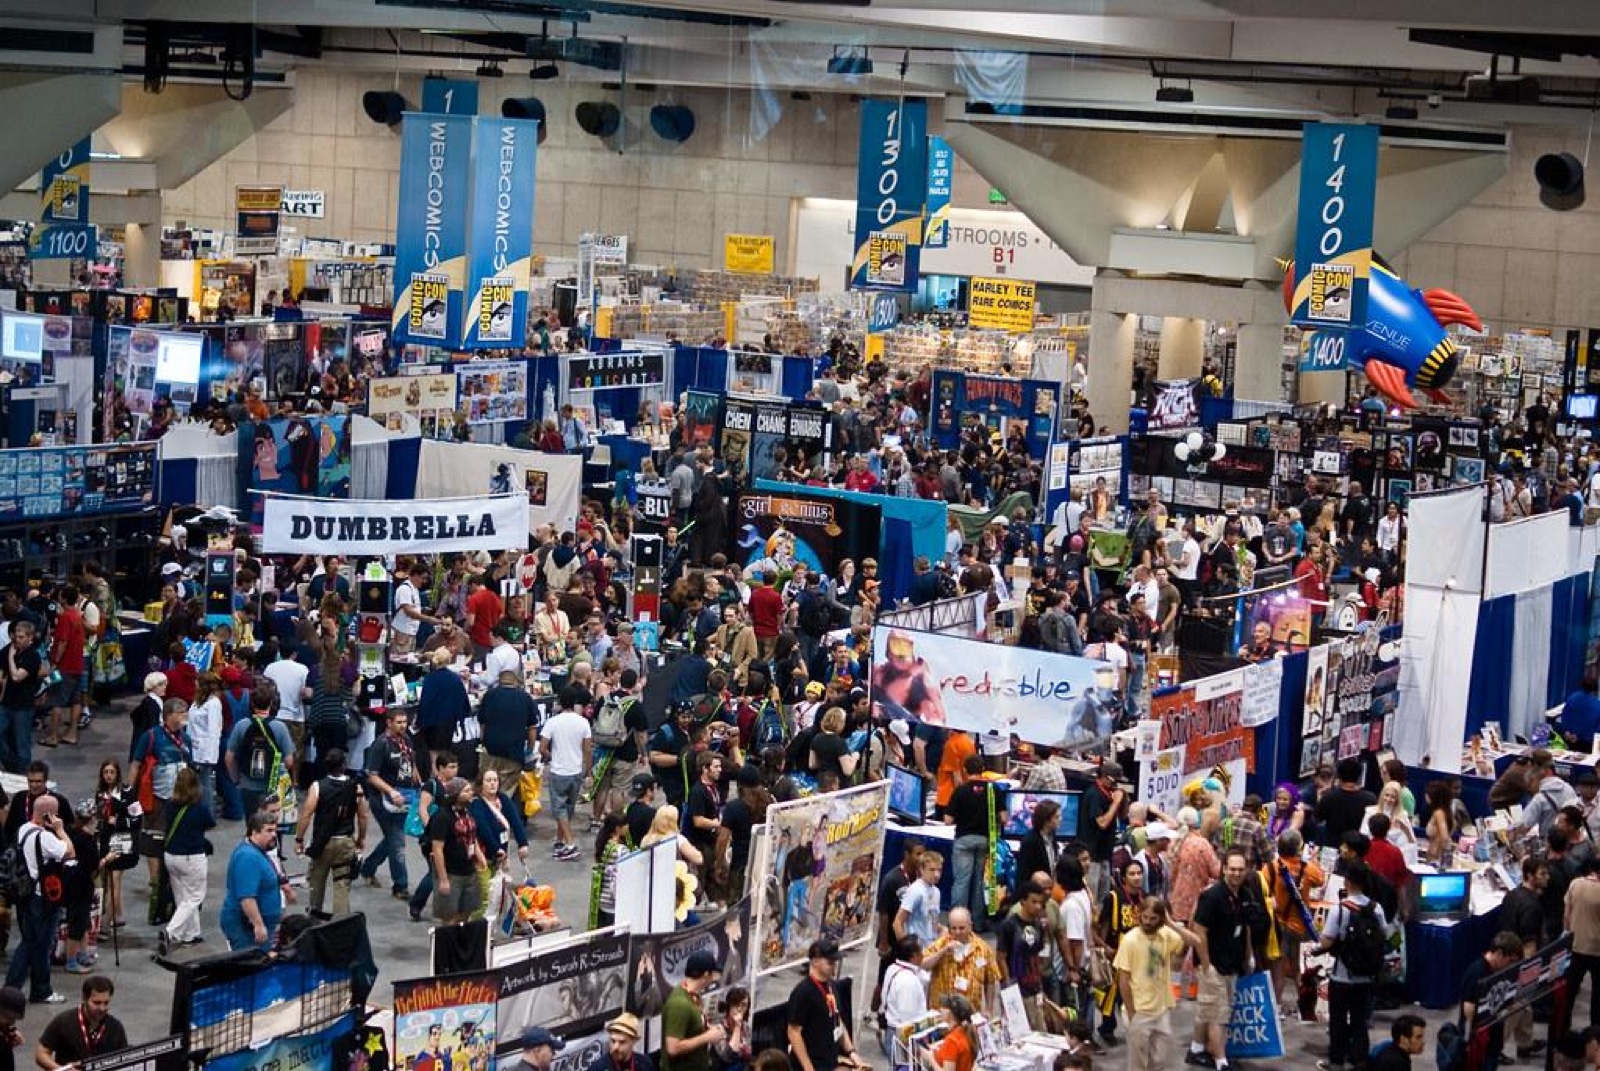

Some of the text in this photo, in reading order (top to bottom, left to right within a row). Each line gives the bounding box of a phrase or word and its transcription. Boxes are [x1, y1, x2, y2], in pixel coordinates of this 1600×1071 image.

[877, 111, 899, 224] 1300
[424, 122, 446, 269] WEBCOMICS
[493, 126, 516, 273] WEBCOMICS
[1320, 133, 1346, 255] 1400
[281, 202, 323, 214] ART
[49, 231, 87, 255] 1100
[947, 227, 1027, 248] STROOMS
[424, 282, 446, 298] CON
[973, 281, 1032, 298] HARLEY YEE
[1312, 271, 1325, 311] COMIC
[1326, 272, 1350, 288] CON
[411, 280, 423, 327] COMIC
[493, 287, 513, 302] CON
[973, 297, 1030, 311] RARE COMICS
[480, 286, 492, 331] COMIC
[588, 355, 644, 371] ABRAMS
[1313, 338, 1344, 366] 1400
[725, 410, 752, 430] CHEN
[757, 415, 786, 434] CHANG
[744, 496, 771, 519] girl
[290, 513, 497, 542] DUMBRELLA
[940, 671, 991, 697] red
[1018, 668, 1077, 700] blue
[1156, 773, 1179, 794] DVD
[1231, 1005, 1267, 1025] ACK
